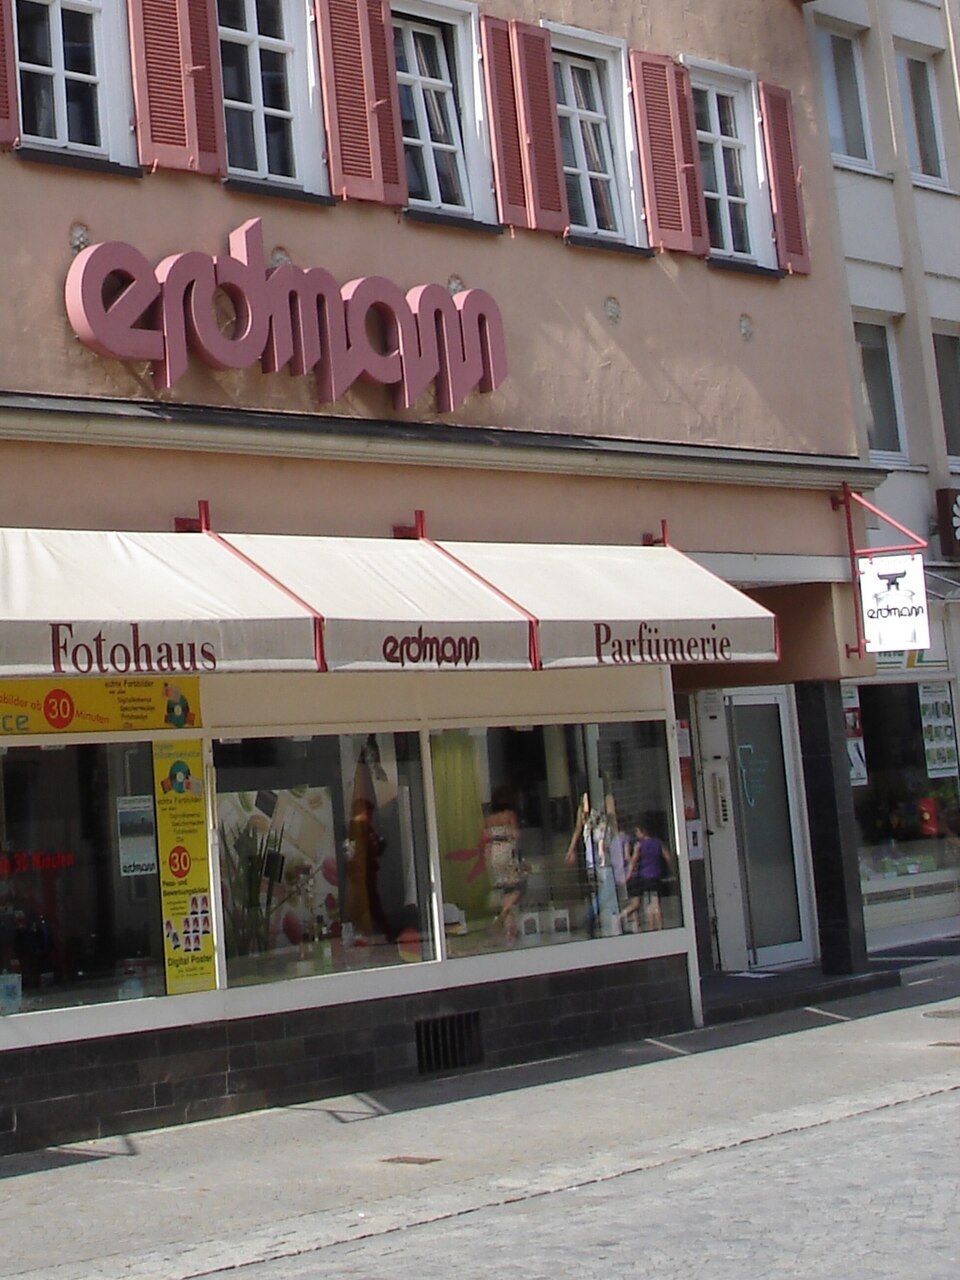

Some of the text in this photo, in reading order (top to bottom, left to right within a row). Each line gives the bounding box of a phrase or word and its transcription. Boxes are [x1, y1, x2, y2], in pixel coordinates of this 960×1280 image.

[65, 217, 507, 413] erdmann
[867, 604, 924, 620] erdmann
[49, 622, 217, 675] Fotohaus
[382, 626, 480, 668] erdmann
[593, 621, 732, 665] Parfümerie
[48, 698, 71, 719] 30
[171, 852, 190, 872] 30
[167, 953, 213, 968] Digital Poster
